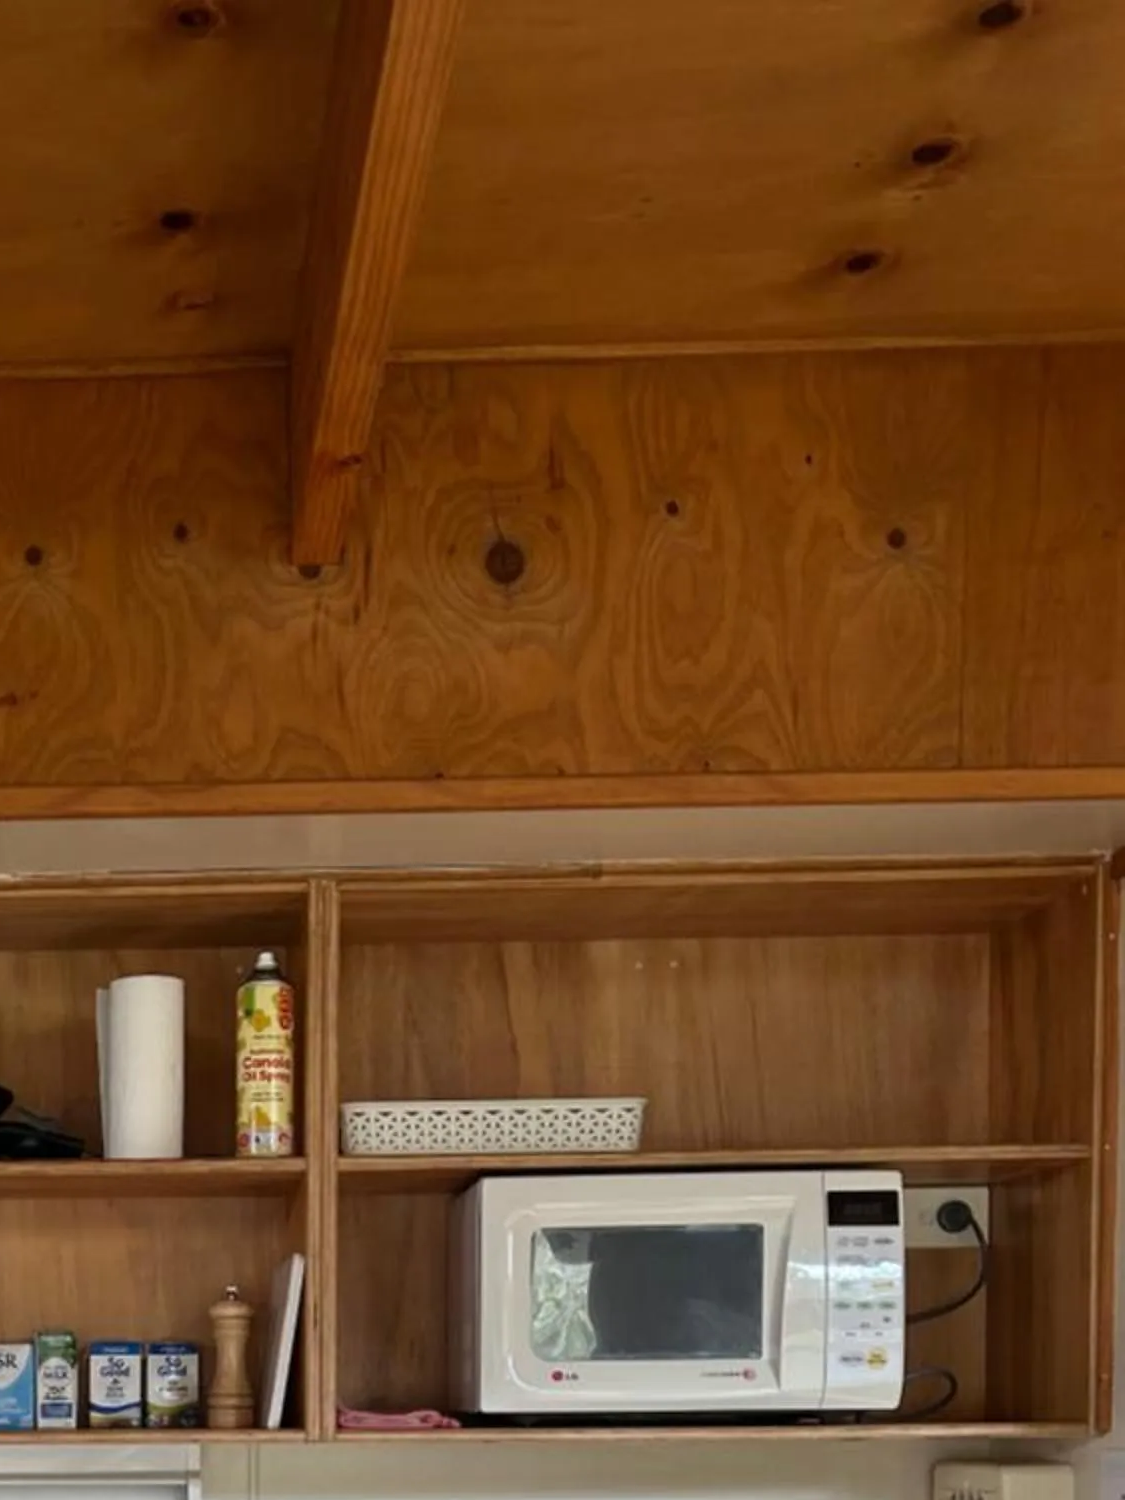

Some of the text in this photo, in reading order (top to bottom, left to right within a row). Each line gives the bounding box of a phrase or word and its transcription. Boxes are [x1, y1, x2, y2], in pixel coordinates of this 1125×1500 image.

[242, 1056, 292, 1070] Canola
[242, 1070, 291, 1083] Oil Spray
